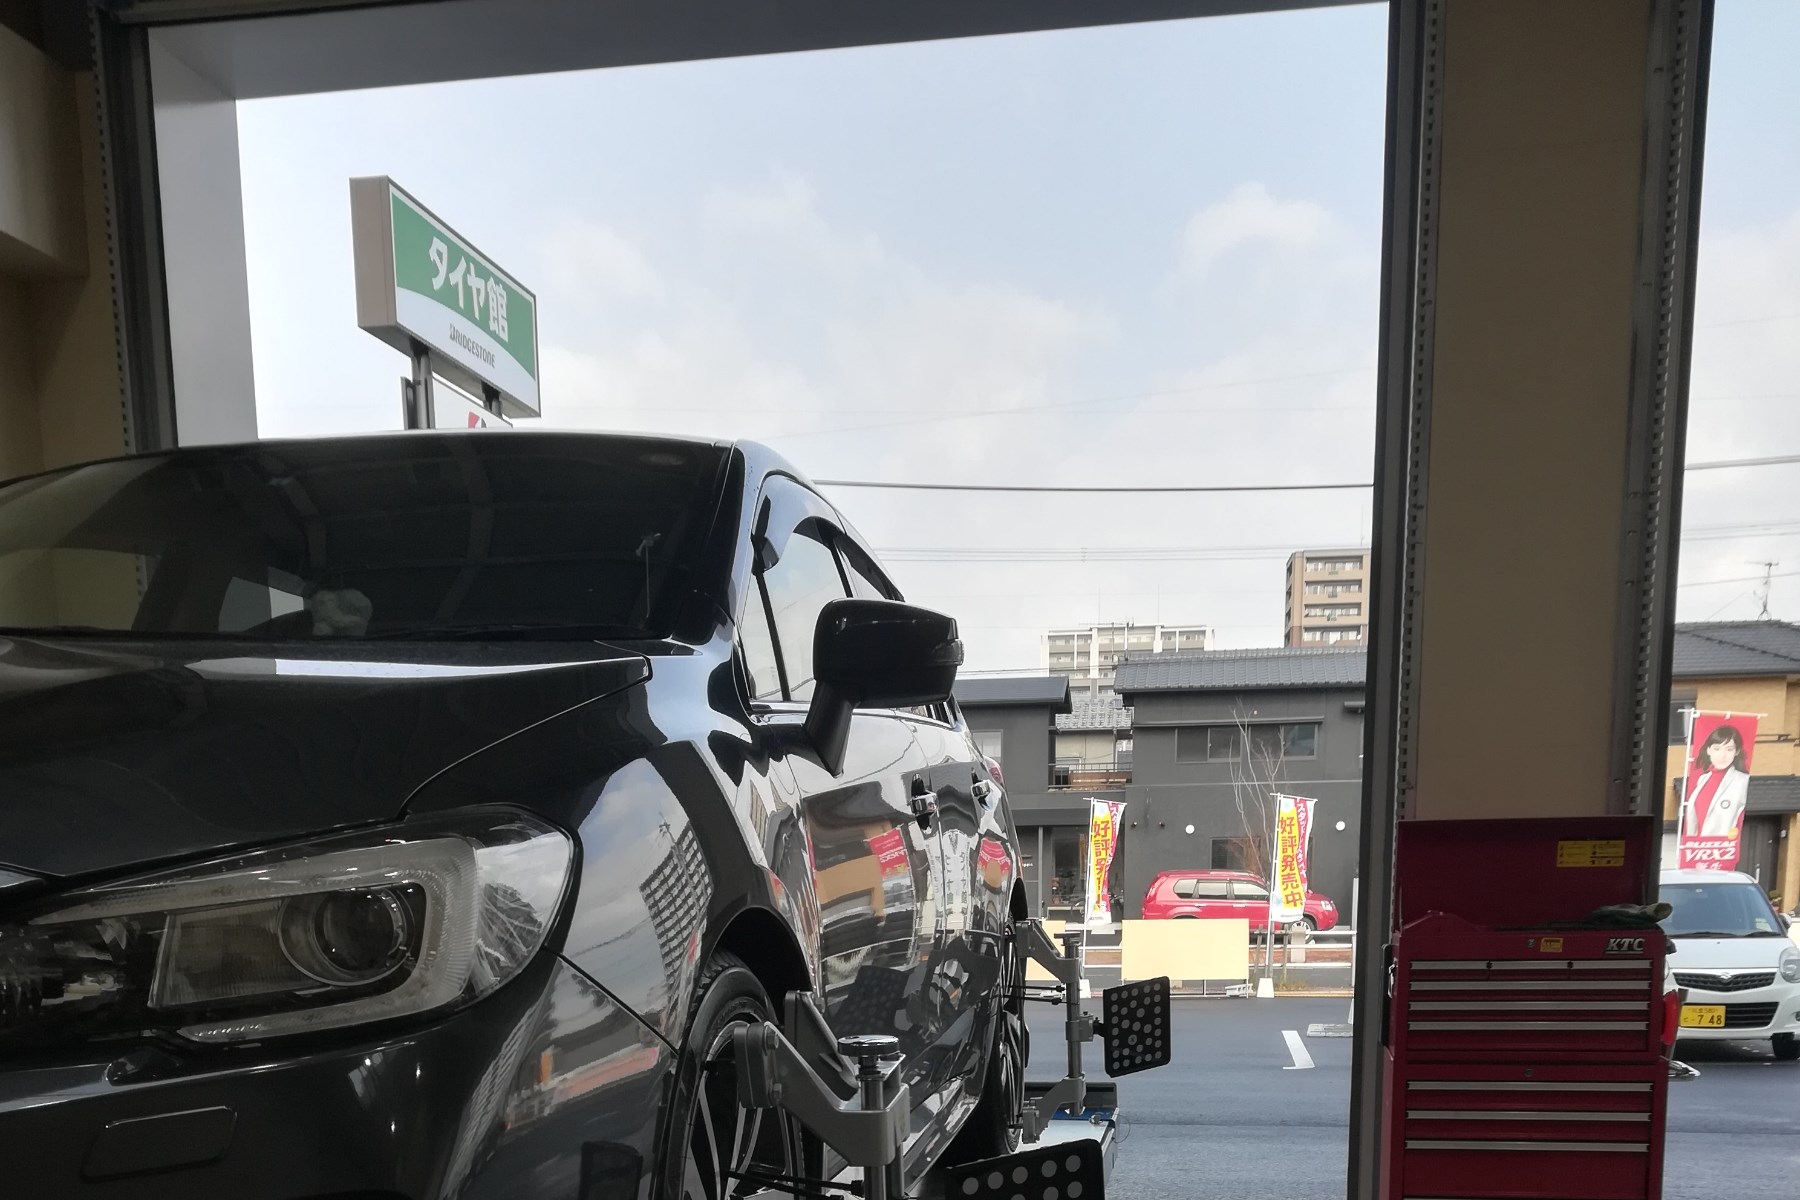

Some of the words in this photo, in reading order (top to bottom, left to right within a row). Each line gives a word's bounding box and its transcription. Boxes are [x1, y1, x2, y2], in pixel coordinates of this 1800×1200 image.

[429, 236, 508, 342] タイヤ館
[449, 323, 495, 368] BRIDGESTONE
[1280, 816, 1303, 907] 好評発売中
[1685, 847, 1736, 862] VRX2
[1606, 938, 1645, 951] KTC
